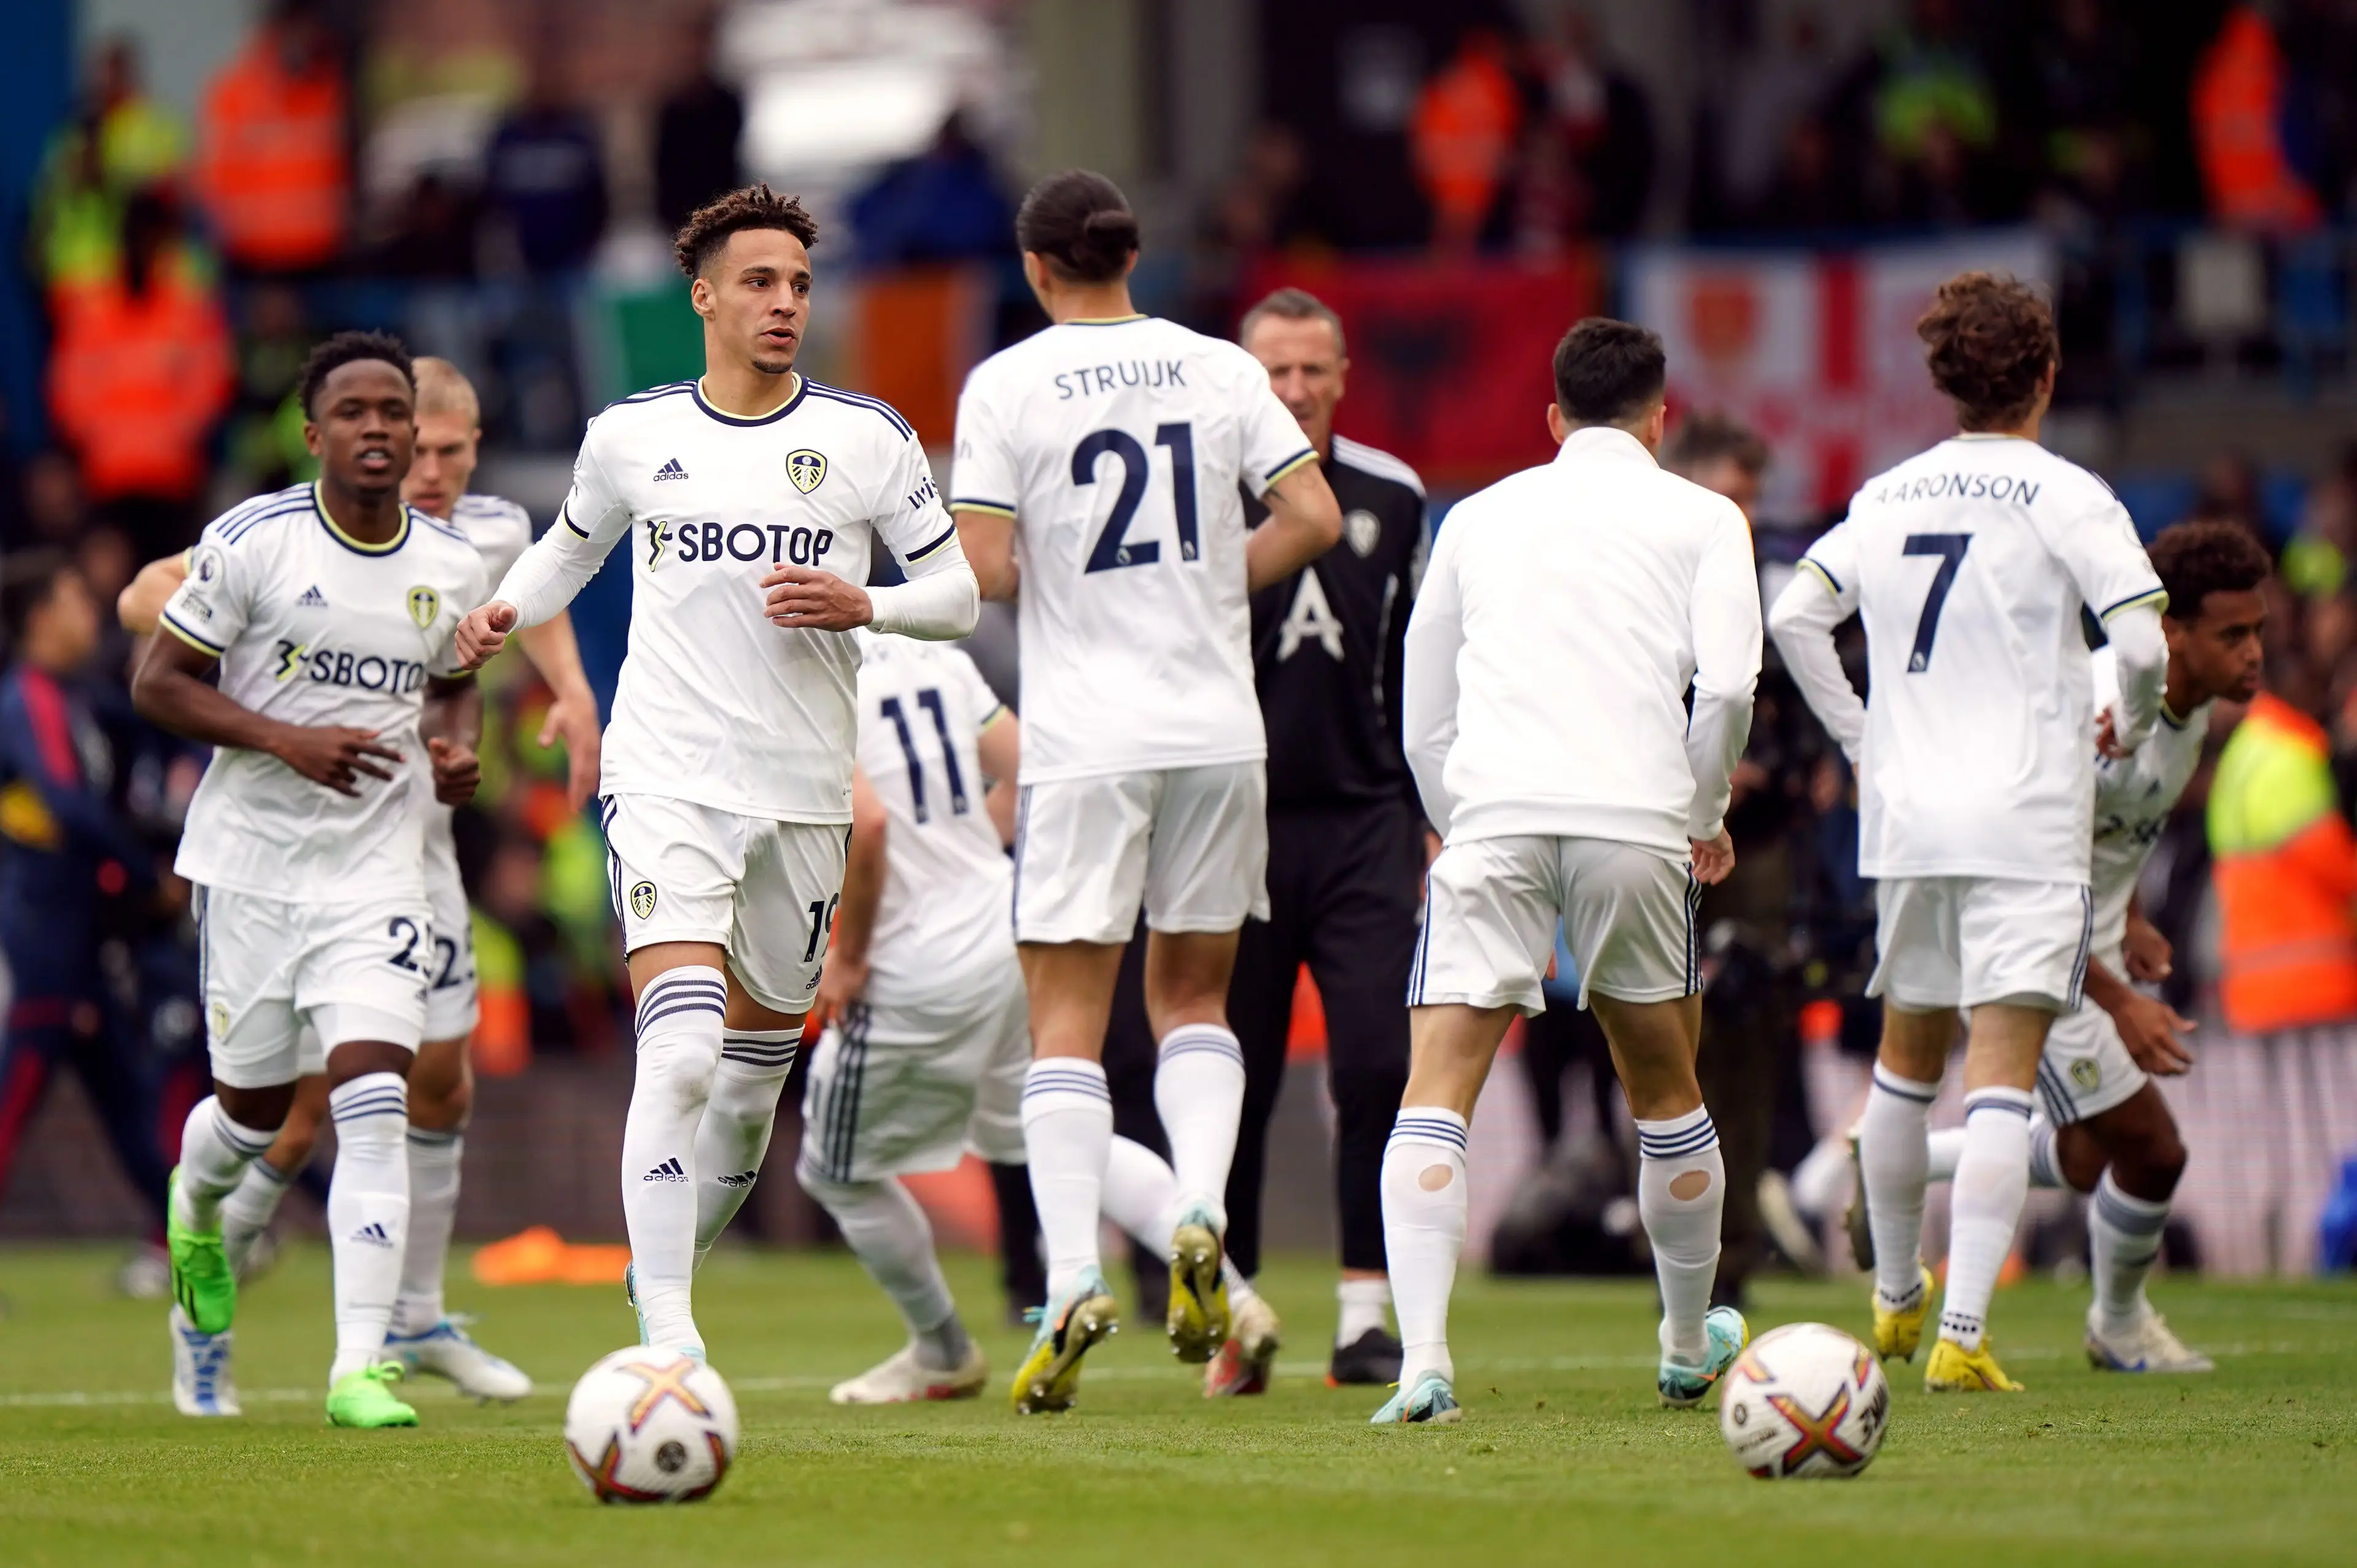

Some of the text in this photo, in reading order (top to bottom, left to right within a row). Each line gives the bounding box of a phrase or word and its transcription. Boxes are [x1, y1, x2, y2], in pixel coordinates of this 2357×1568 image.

[1054, 359, 1187, 401] STRUIJK
[653, 472, 689, 482] adidas
[1070, 422, 1199, 576] 21
[1875, 473, 2040, 505] AARONSON
[678, 522, 834, 566] SBOTOP
[1275, 565, 1345, 662] A
[1901, 533, 1975, 673] 7
[311, 649, 425, 693] SBOTO
[880, 688, 969, 824] 11
[388, 916, 432, 980] 2
[643, 1172, 689, 1183] adidas
[717, 1176, 756, 1188] adida
